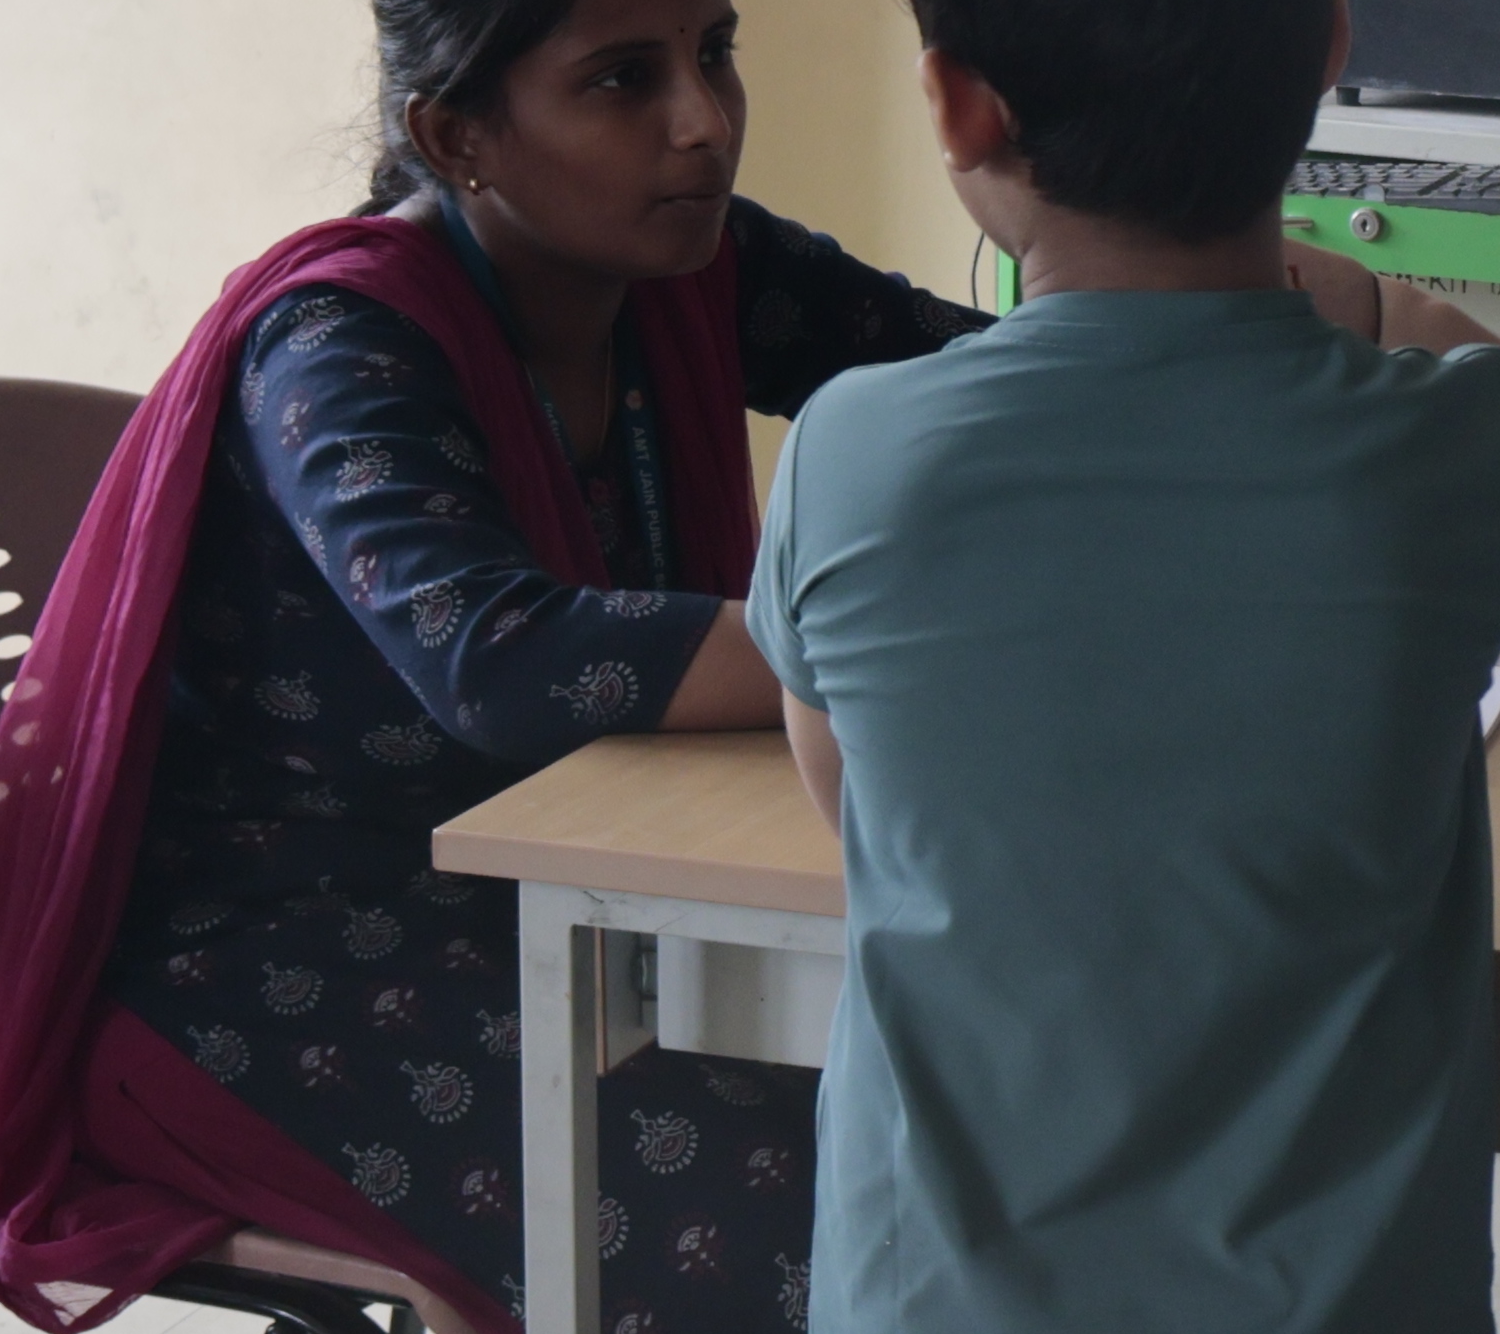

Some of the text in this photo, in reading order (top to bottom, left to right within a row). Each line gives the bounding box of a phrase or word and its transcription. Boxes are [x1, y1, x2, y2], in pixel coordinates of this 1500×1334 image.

[631, 426, 651, 462] AMT
[638, 469, 657, 506] JAIN
[646, 509, 665, 569] PUBLIC
